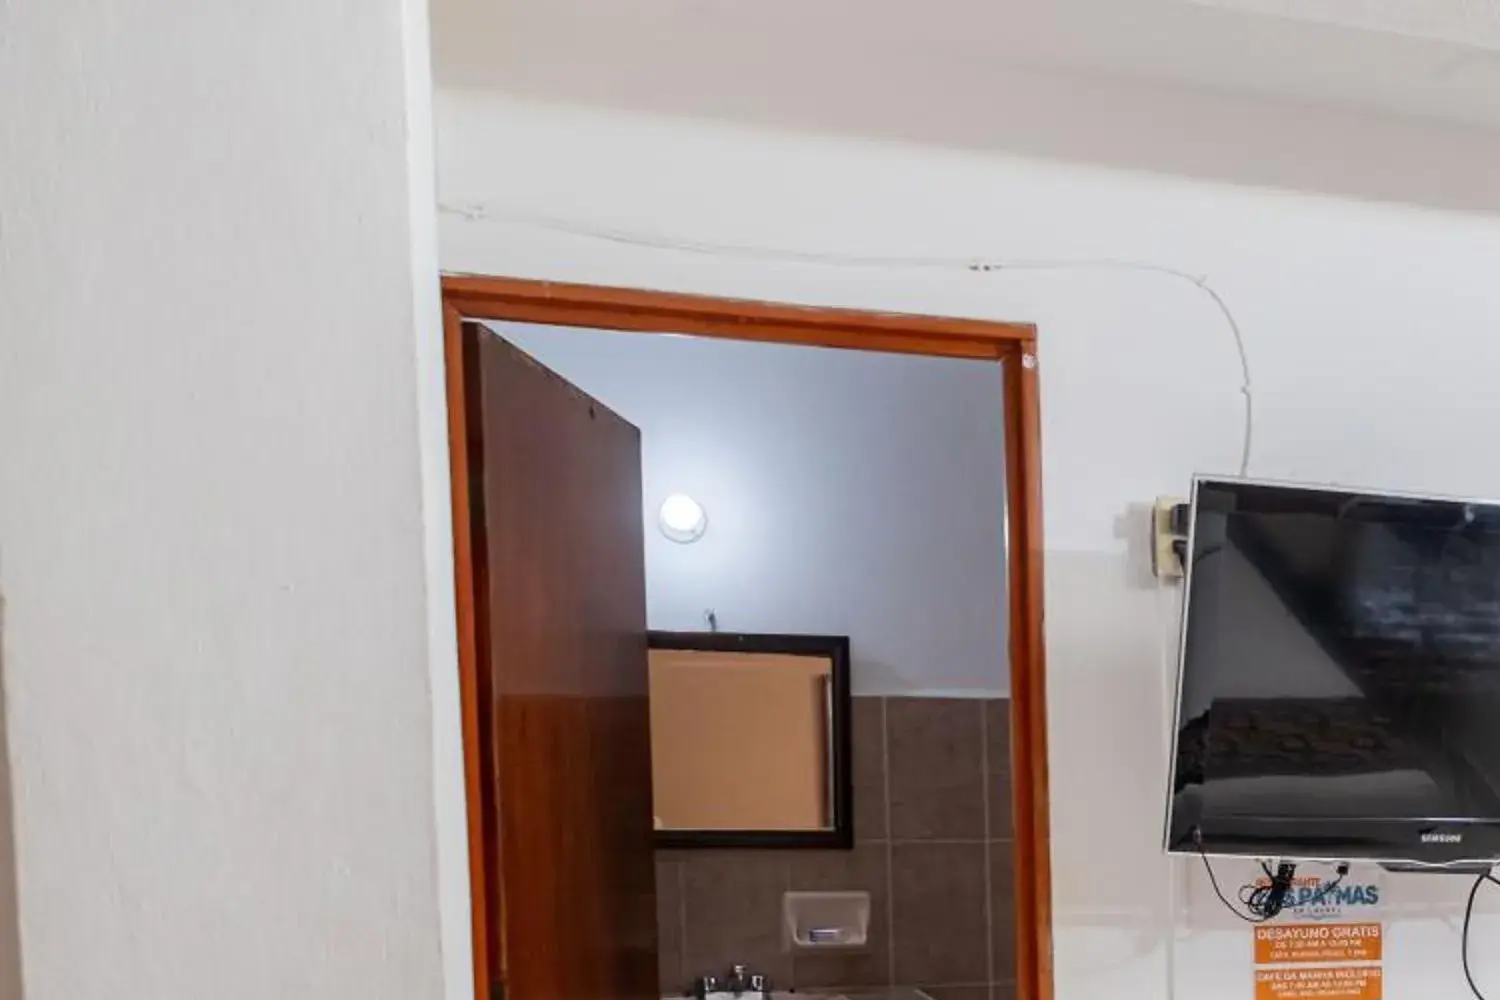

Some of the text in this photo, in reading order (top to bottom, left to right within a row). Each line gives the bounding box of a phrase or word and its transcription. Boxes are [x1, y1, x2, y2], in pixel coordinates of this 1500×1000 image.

[1421, 833, 1461, 843] SAMSUNG
[1300, 884, 1379, 905] PAMAS
[1257, 926, 1379, 939] DESAYUNO GRATIS
